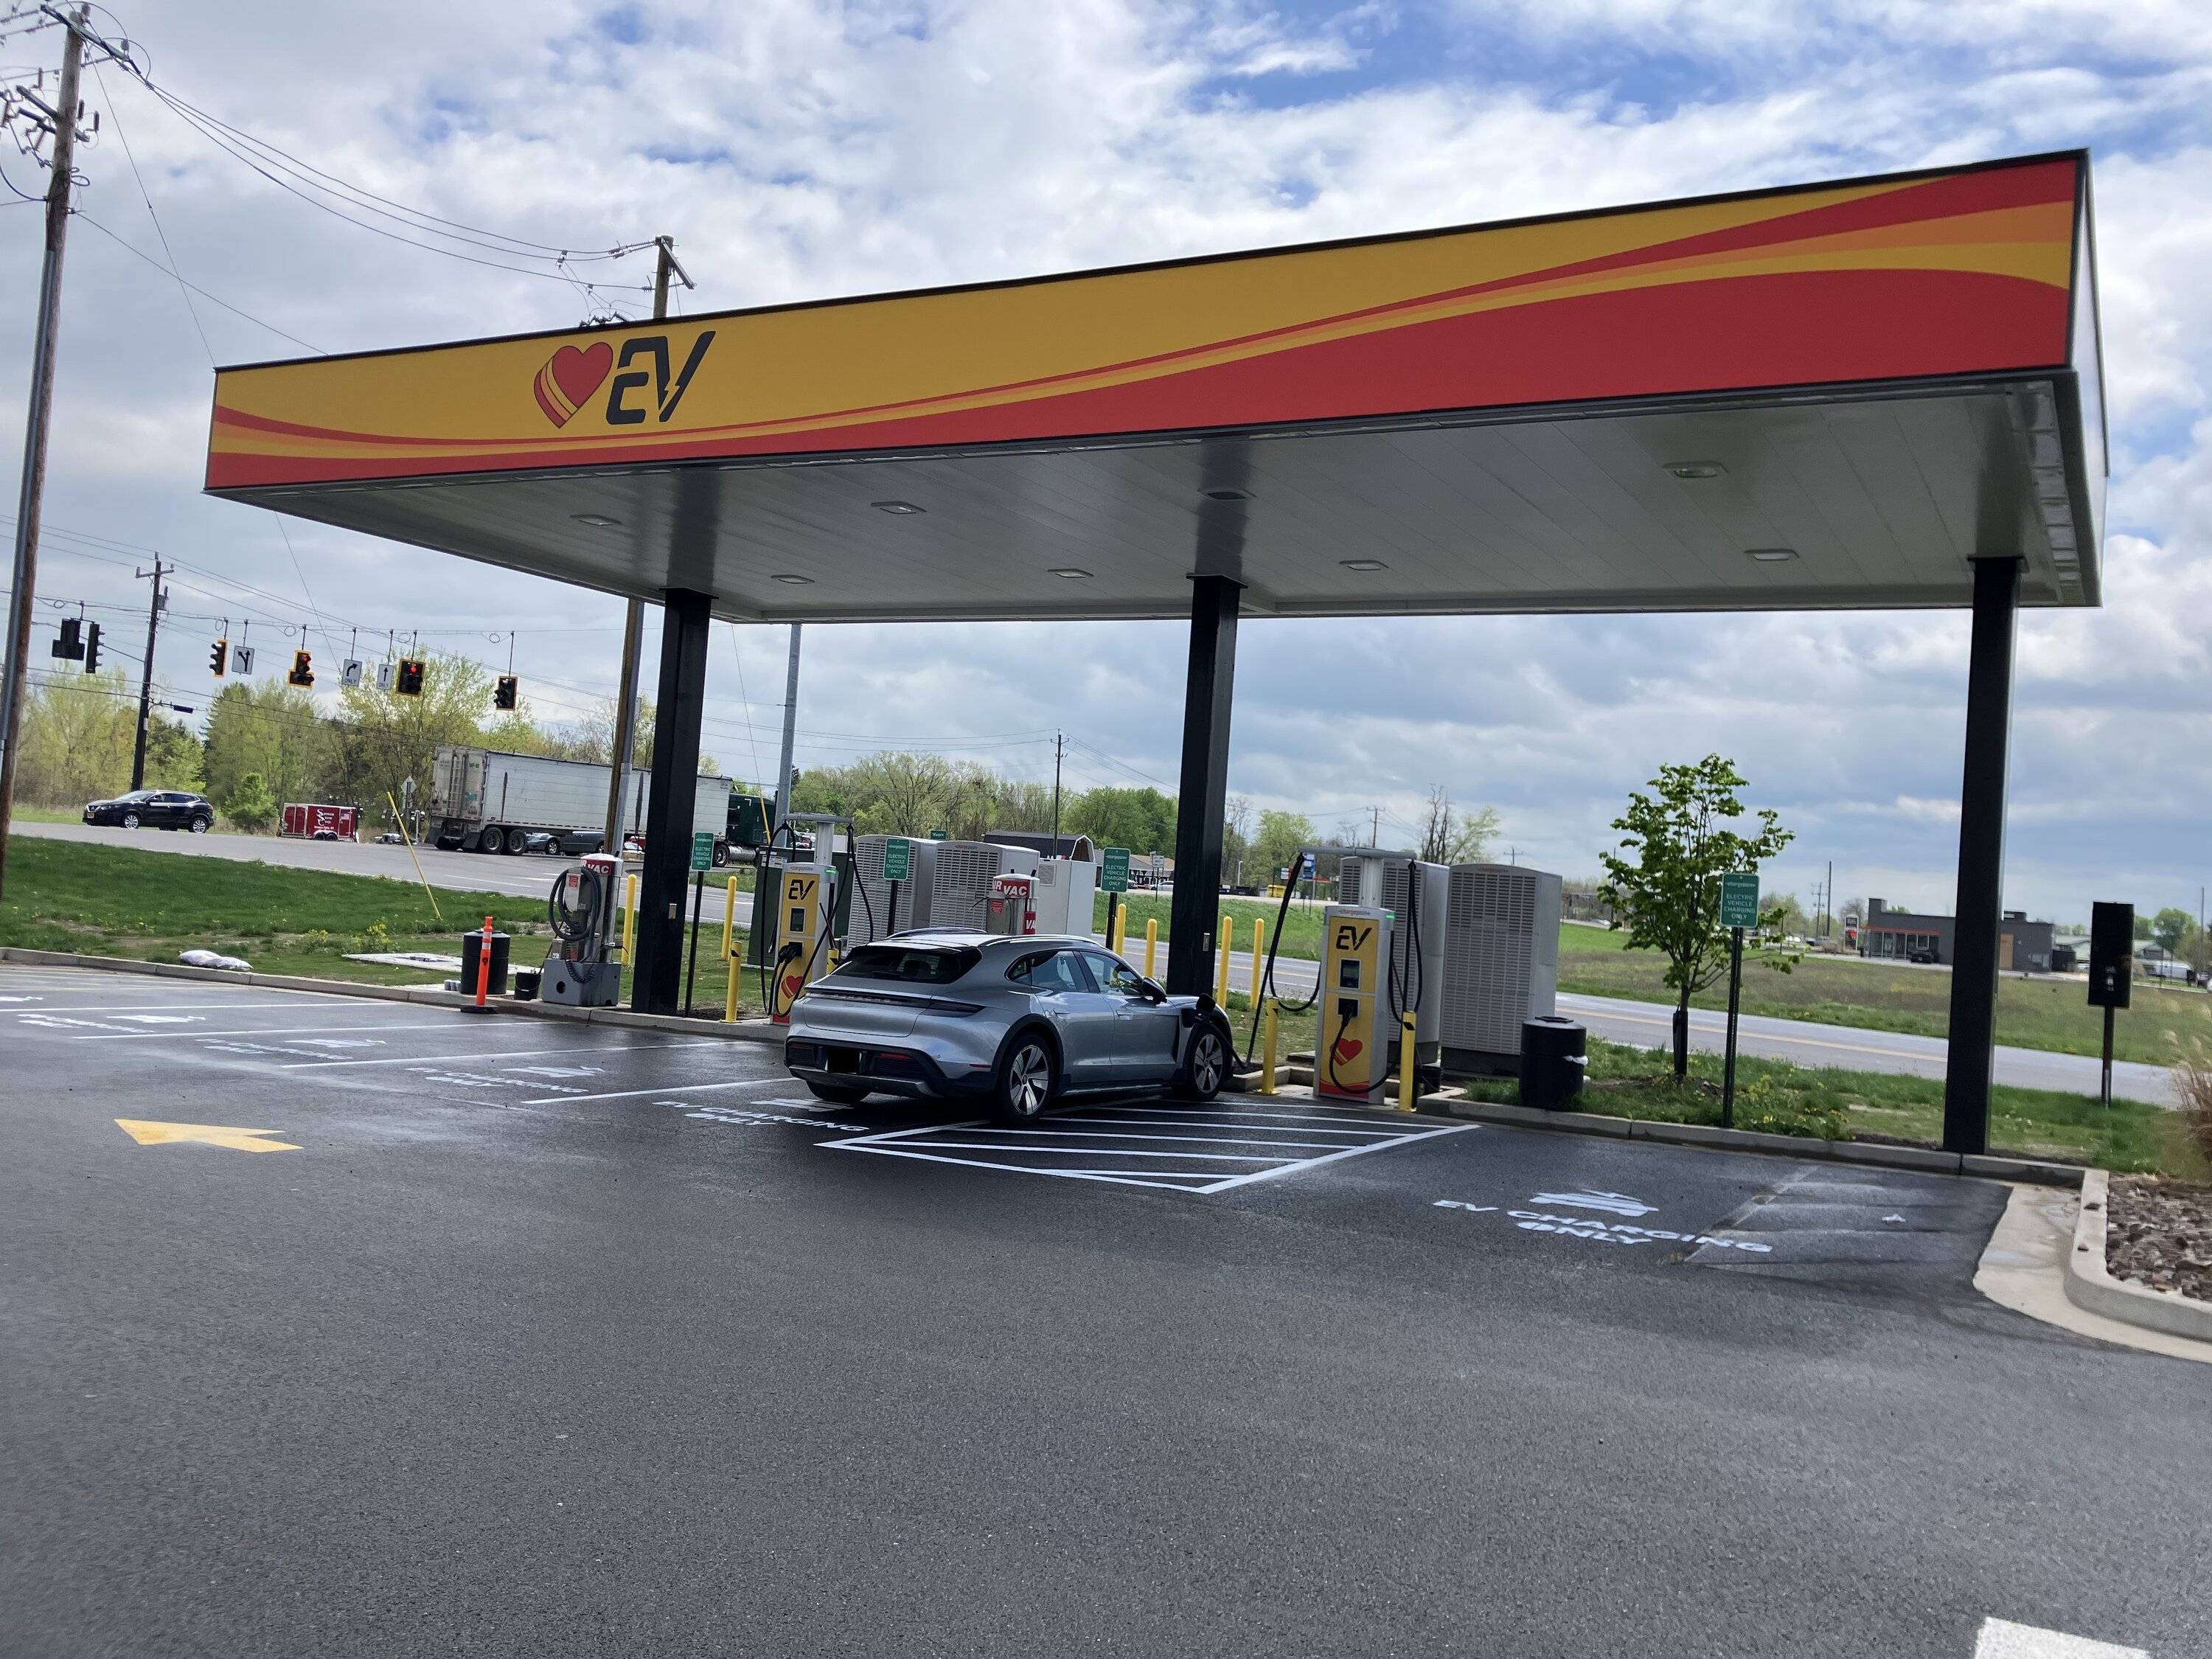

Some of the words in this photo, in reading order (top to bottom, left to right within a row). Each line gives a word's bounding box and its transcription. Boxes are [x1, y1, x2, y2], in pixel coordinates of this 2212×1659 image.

[606, 330, 717, 425] EV
[788, 879, 815, 901] EV
[1004, 885, 1027, 896] VAC
[1724, 905, 1756, 914] CHARGING
[1026, 919, 1035, 930] VA
[1335, 925, 1372, 951] EV
[684, 1113, 776, 1125] ONLY
[700, 1107, 870, 1132] CHARGING
[1433, 1200, 1499, 1211] EV
[1507, 1210, 1773, 1253] CHARGING
[1517, 1222, 1653, 1244] ONLY
